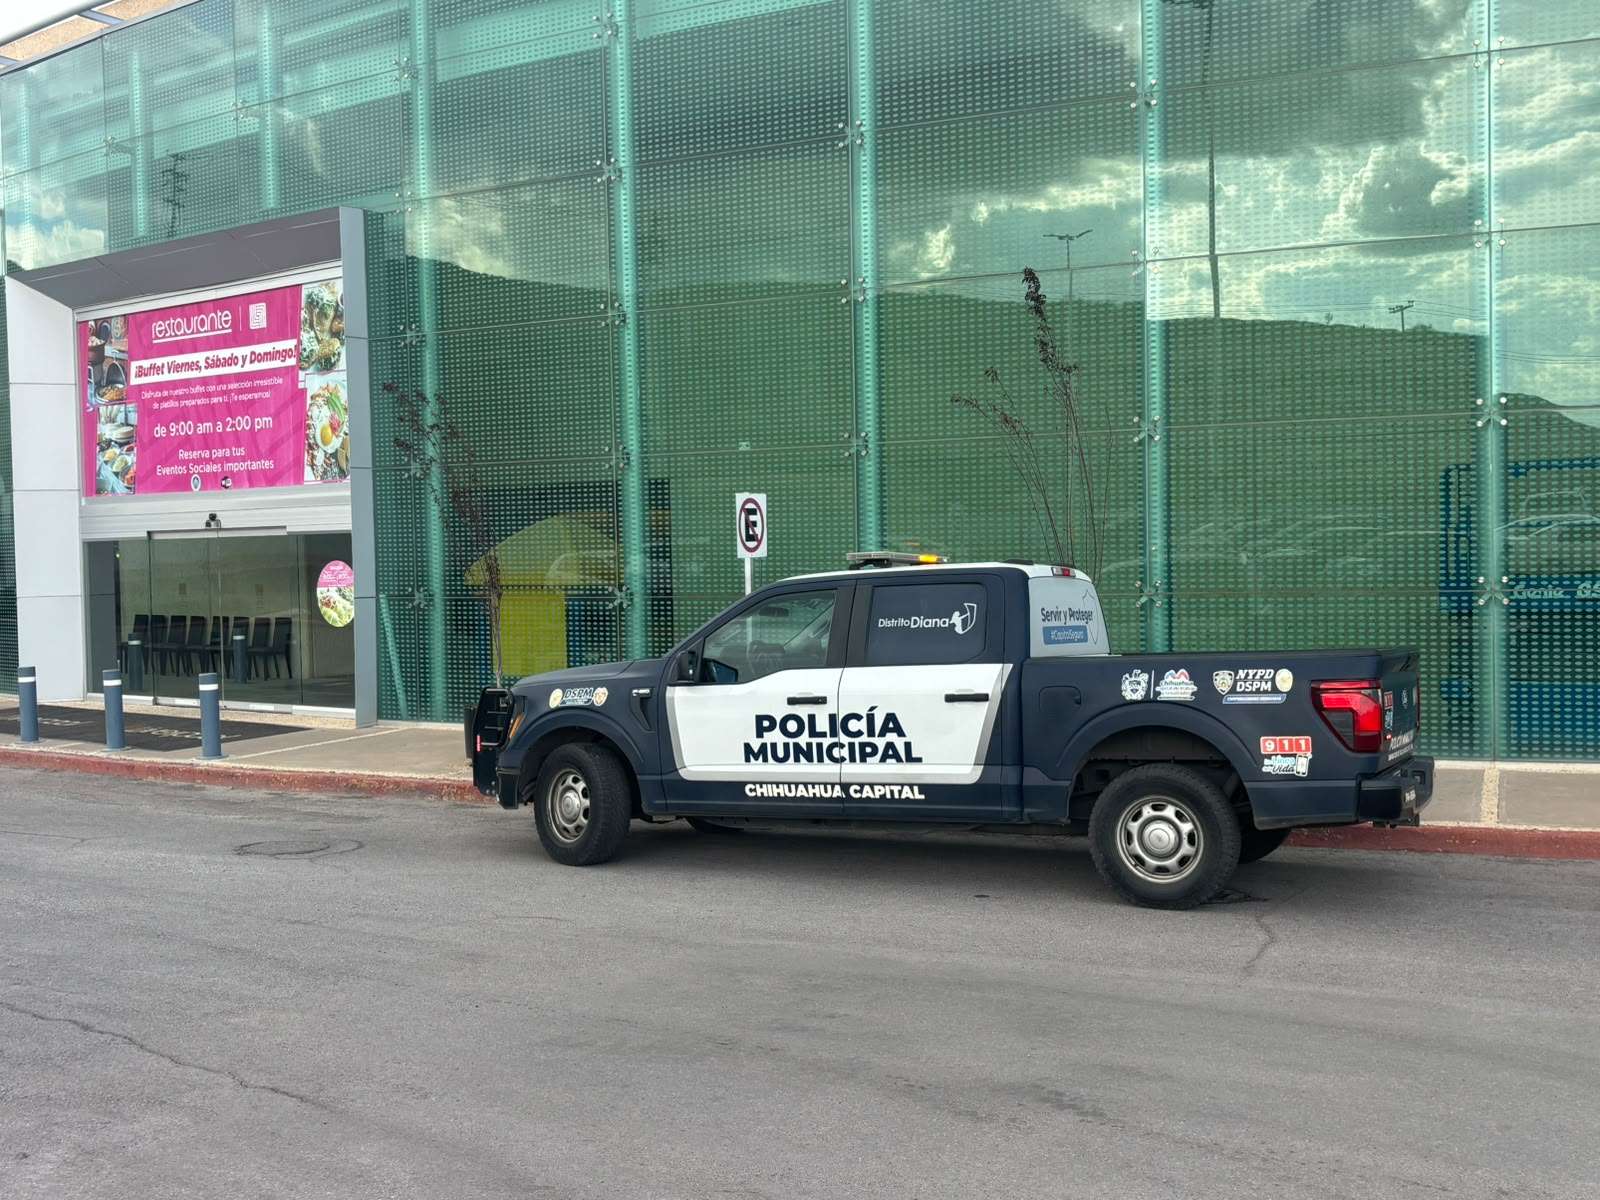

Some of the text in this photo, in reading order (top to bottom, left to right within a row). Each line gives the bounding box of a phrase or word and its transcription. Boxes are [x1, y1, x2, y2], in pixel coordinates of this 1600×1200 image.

[151, 310, 232, 339] restaurante
[134, 345, 298, 378] ¡Buffet Viernes, Sábado y Domingo!
[216, 383, 227, 392] una
[153, 415, 273, 438] de 9:00 am a 2:00 pm
[178, 446, 245, 460] Reserva para tus
[156, 464, 187, 475] Eventos
[188, 461, 222, 473] Sociales
[744, 508, 758, 542] E
[1040, 606, 1093, 625] Servir y Proteger
[1236, 669, 1275, 680] NYPD
[564, 688, 594, 700] DSPM
[1236, 681, 1272, 692] DSPM
[755, 705, 907, 739] POLICÍA
[743, 741, 923, 764] MUNICIPAL
[1265, 739, 1306, 751] 911
[744, 783, 926, 800] CHIHUAHUA CAPITAL
